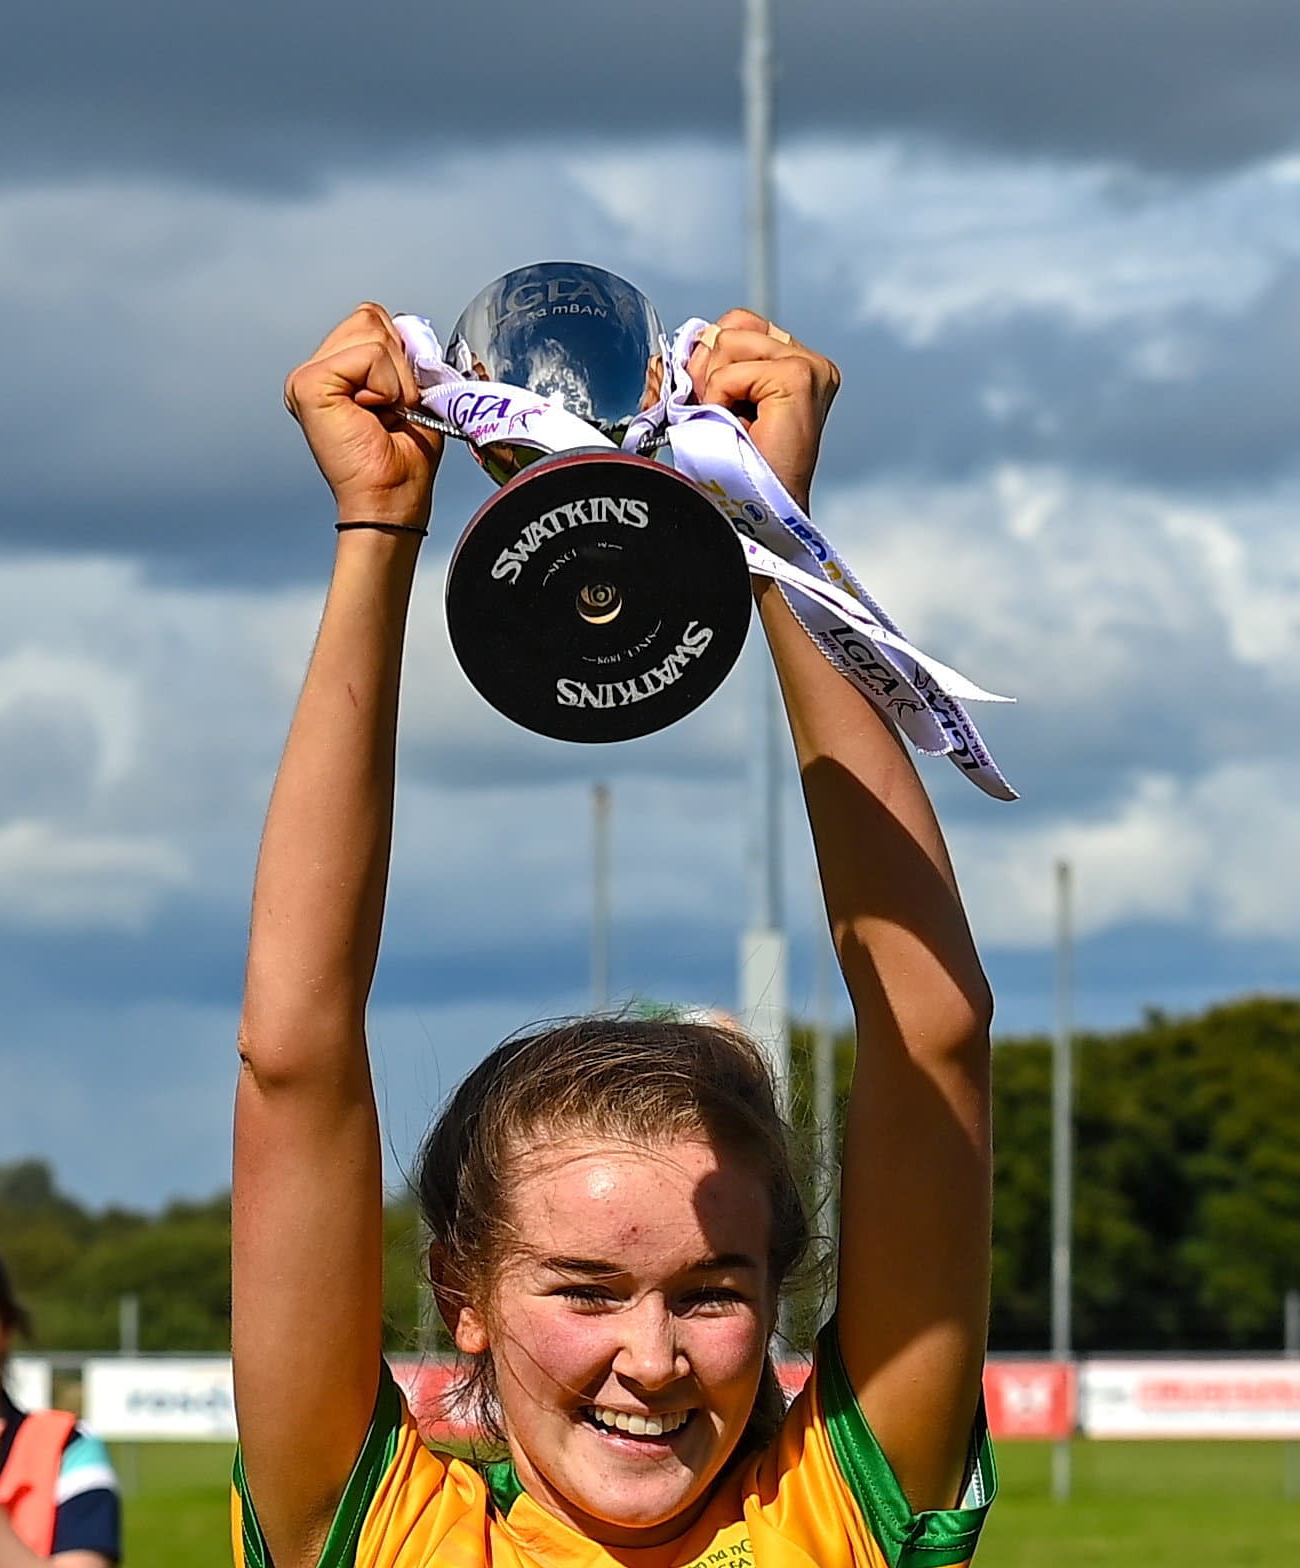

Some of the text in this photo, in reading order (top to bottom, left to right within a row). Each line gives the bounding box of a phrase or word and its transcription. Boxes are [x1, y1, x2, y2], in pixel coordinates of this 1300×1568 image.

[490, 497, 649, 585] SWATKINS
[556, 621, 714, 709] SWATKINS
[817, 631, 838, 653] PEIL
[829, 625, 899, 697] LGFA
